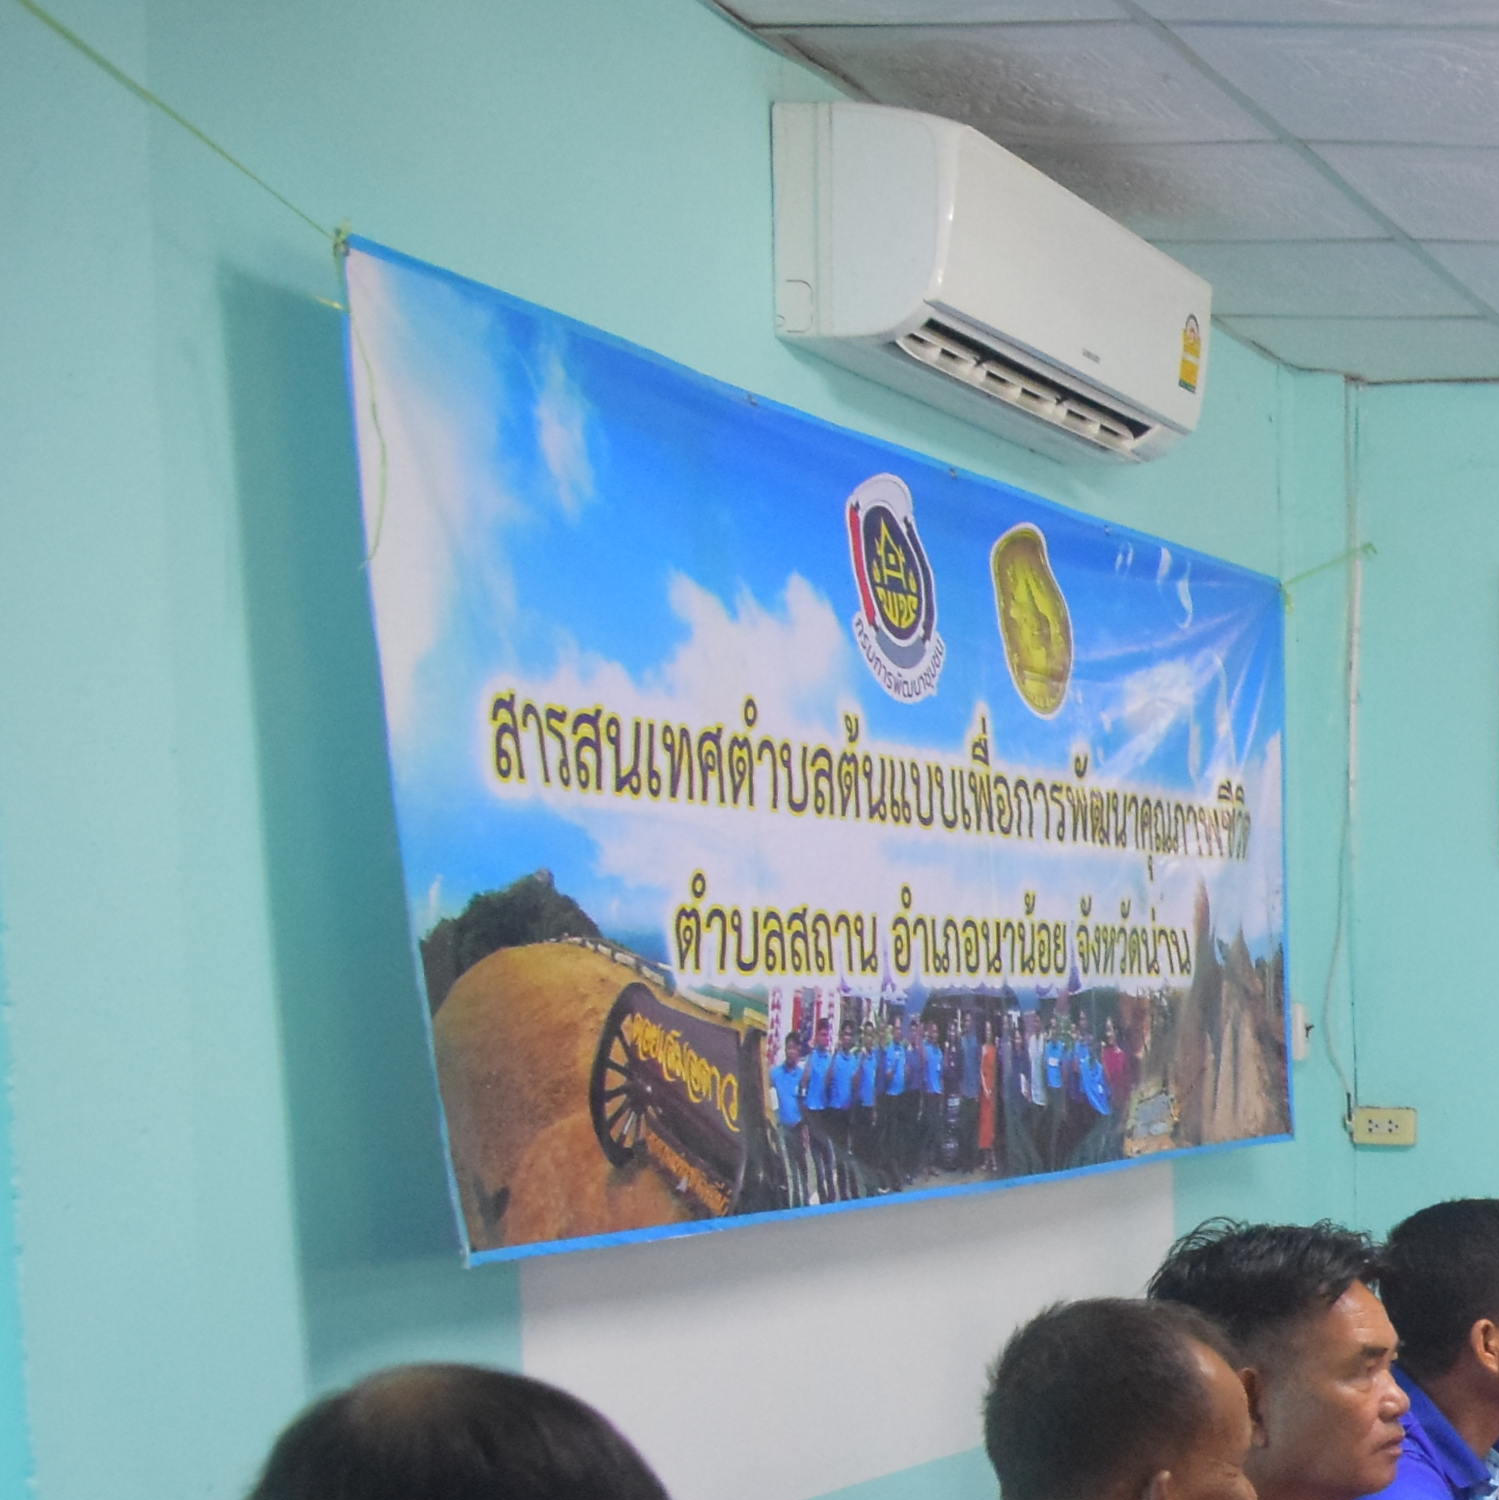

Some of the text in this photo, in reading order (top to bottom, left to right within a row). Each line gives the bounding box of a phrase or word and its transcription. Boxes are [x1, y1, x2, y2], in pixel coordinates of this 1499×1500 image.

[490, 692, 1252, 880] สารสนเทศตำบลต้นแบบเพื่อการพัฒนาคุณภาพชีวิต
[675, 872, 1192, 977] ตำบลสถาน อำเภอนาน้อย จังหวัดน่าน
